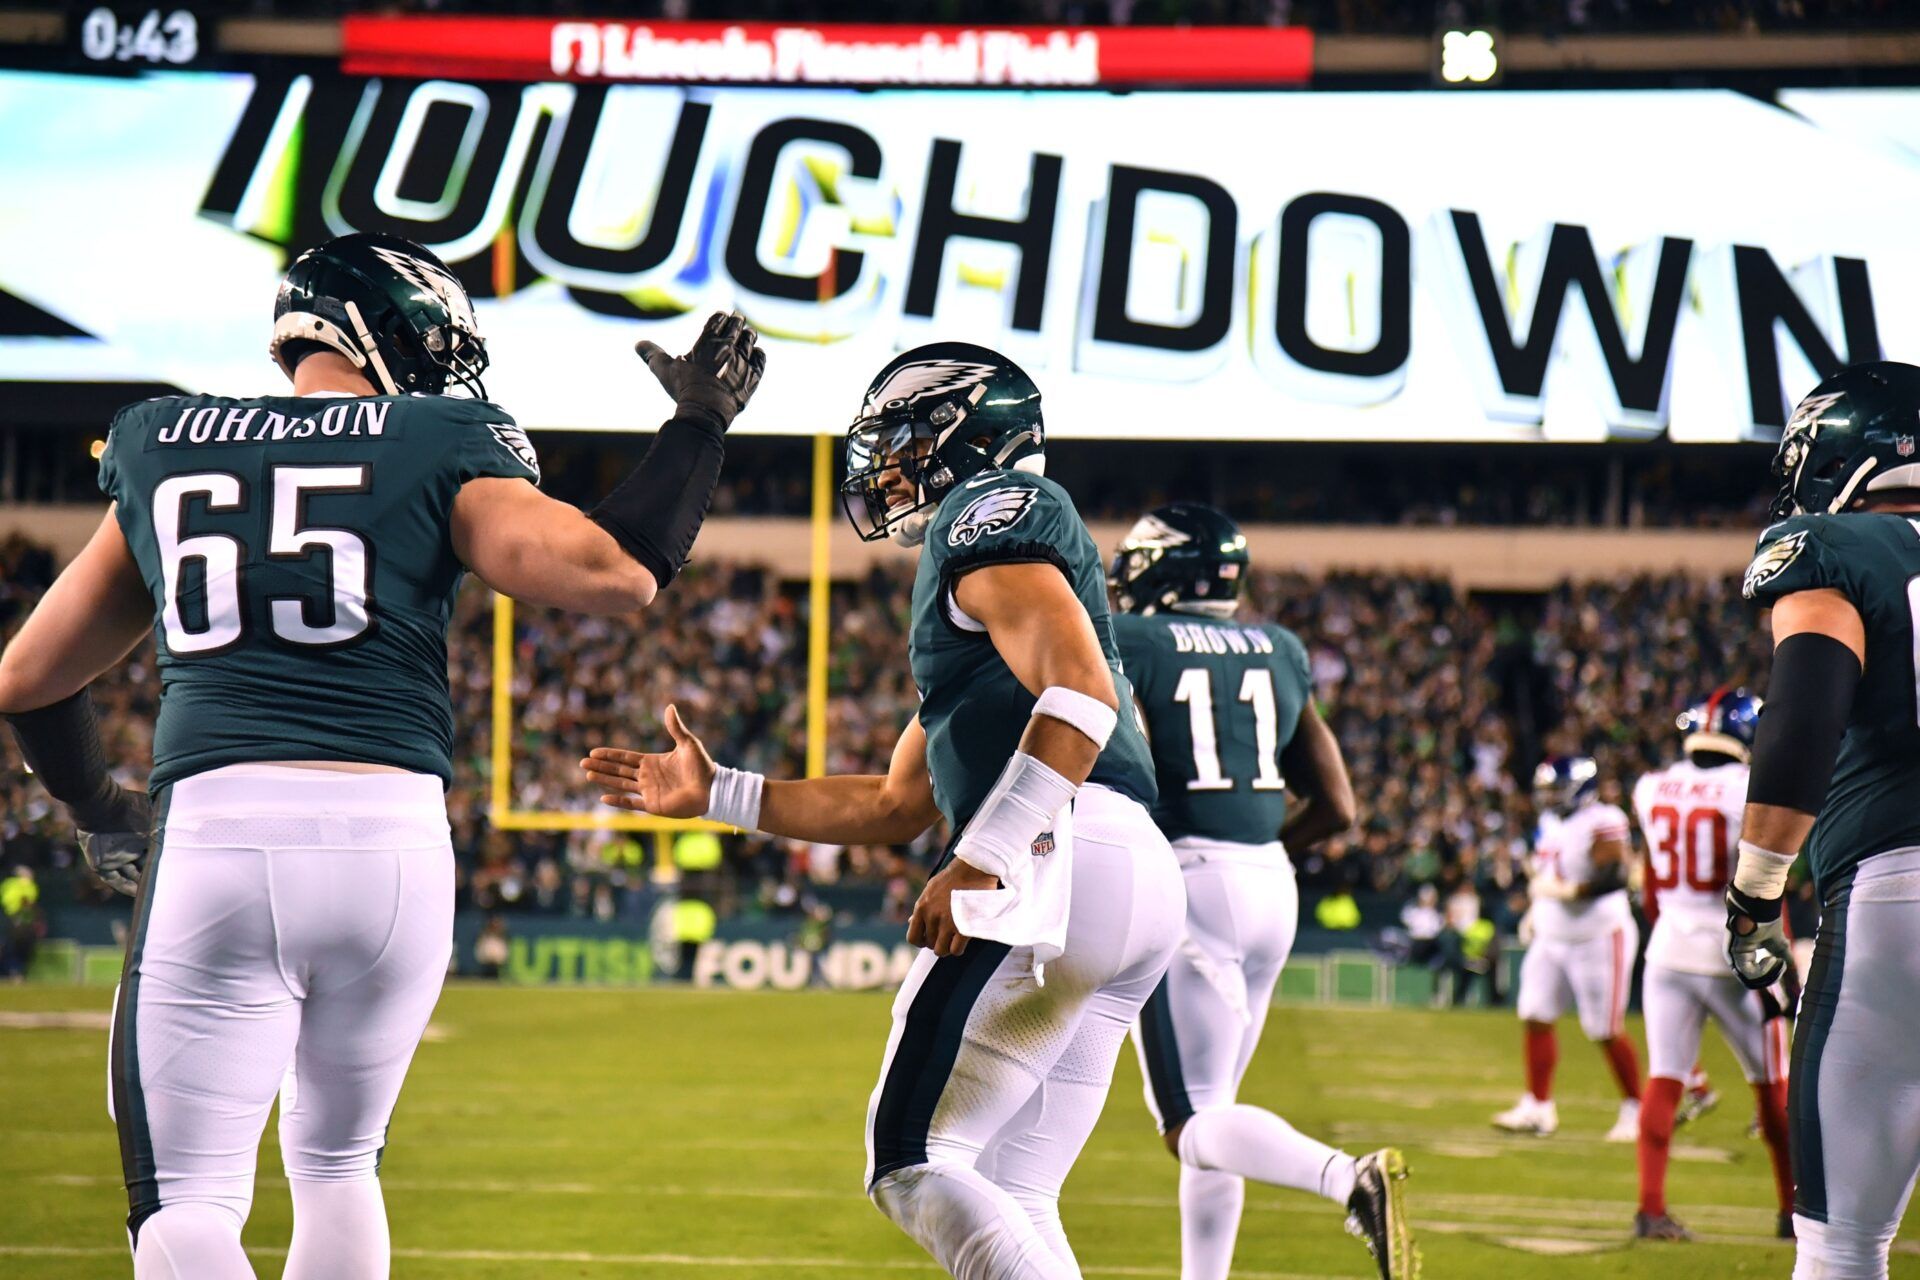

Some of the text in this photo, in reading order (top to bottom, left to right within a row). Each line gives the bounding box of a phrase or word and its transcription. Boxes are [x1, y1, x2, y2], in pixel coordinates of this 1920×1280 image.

[82, 7, 198, 64] 0:43
[601, 23, 1099, 85] Lincoln Financial Field
[157, 402, 392, 443] JOHNSON
[151, 462, 375, 657] 65
[1168, 622, 1273, 654] BROWN
[1173, 668, 1285, 790] 11
[1651, 806, 1728, 892] 30
